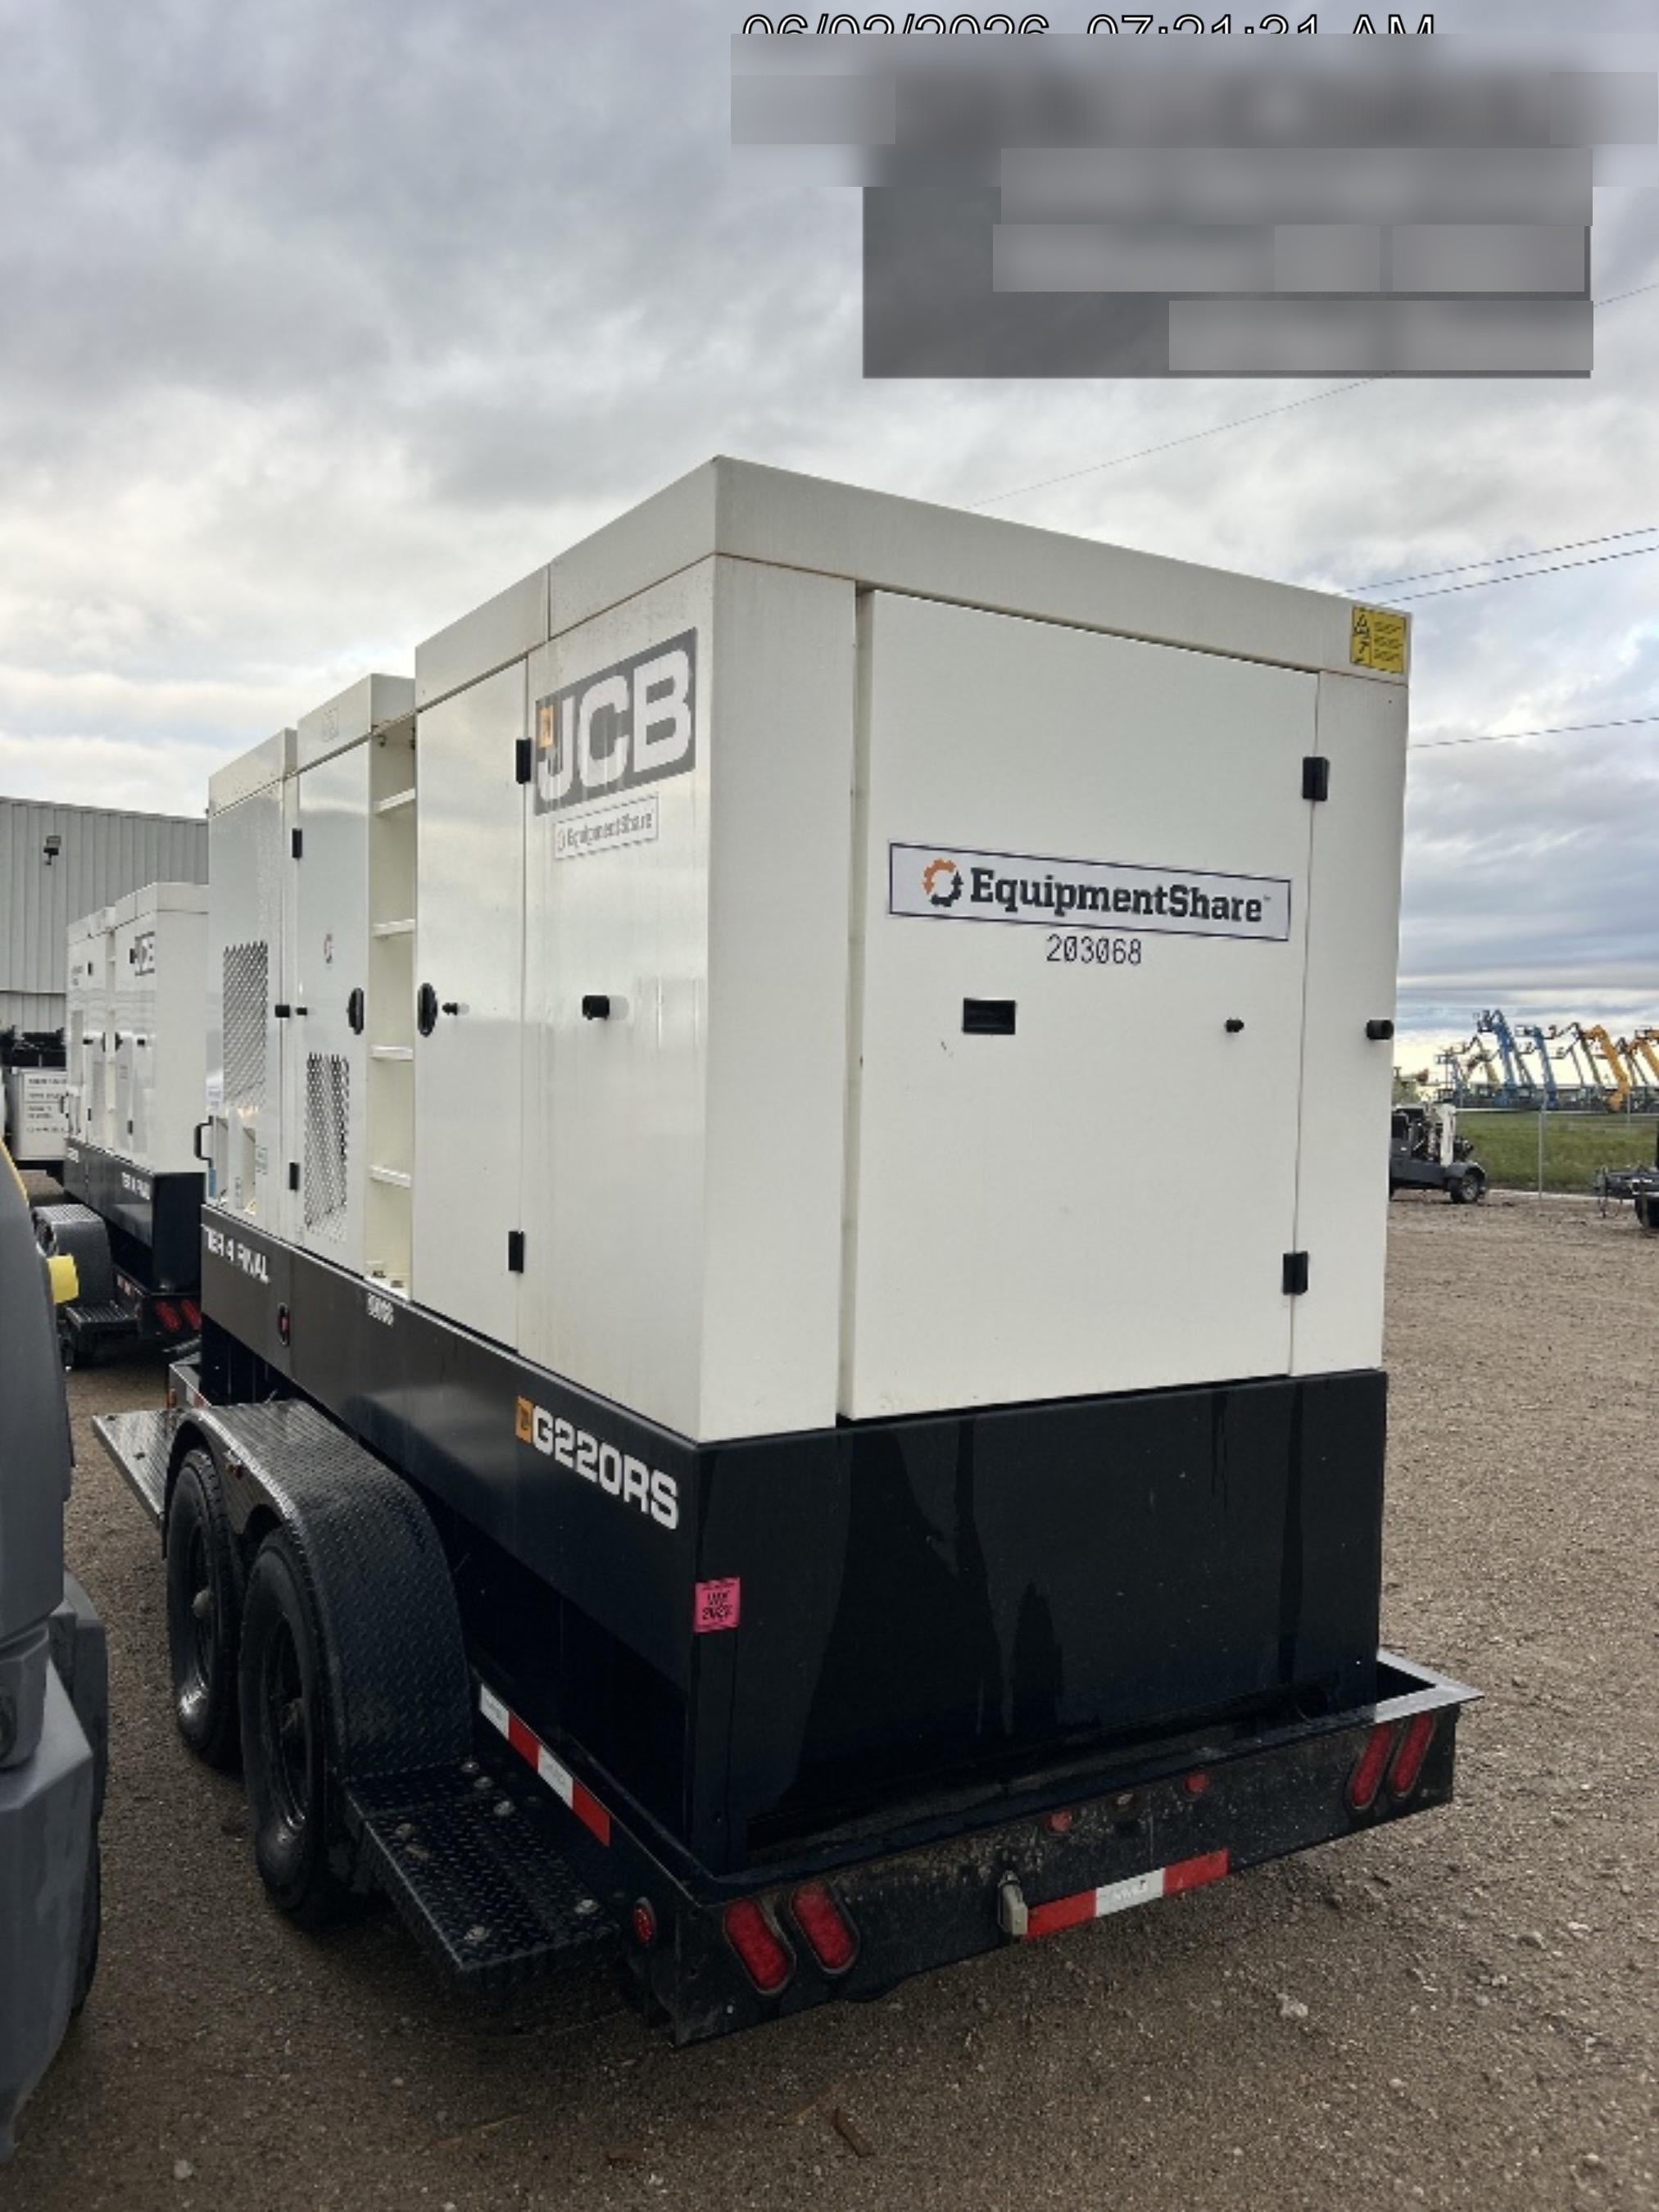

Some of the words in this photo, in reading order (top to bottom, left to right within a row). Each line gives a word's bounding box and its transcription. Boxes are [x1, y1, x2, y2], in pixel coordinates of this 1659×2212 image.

[537, 648, 691, 800] JCB
[567, 813, 652, 849] EquipmentShare
[971, 867, 1262, 922] EquipmentShare
[1046, 933, 1142, 965] 203068
[533, 1404, 679, 1530] G220RS
